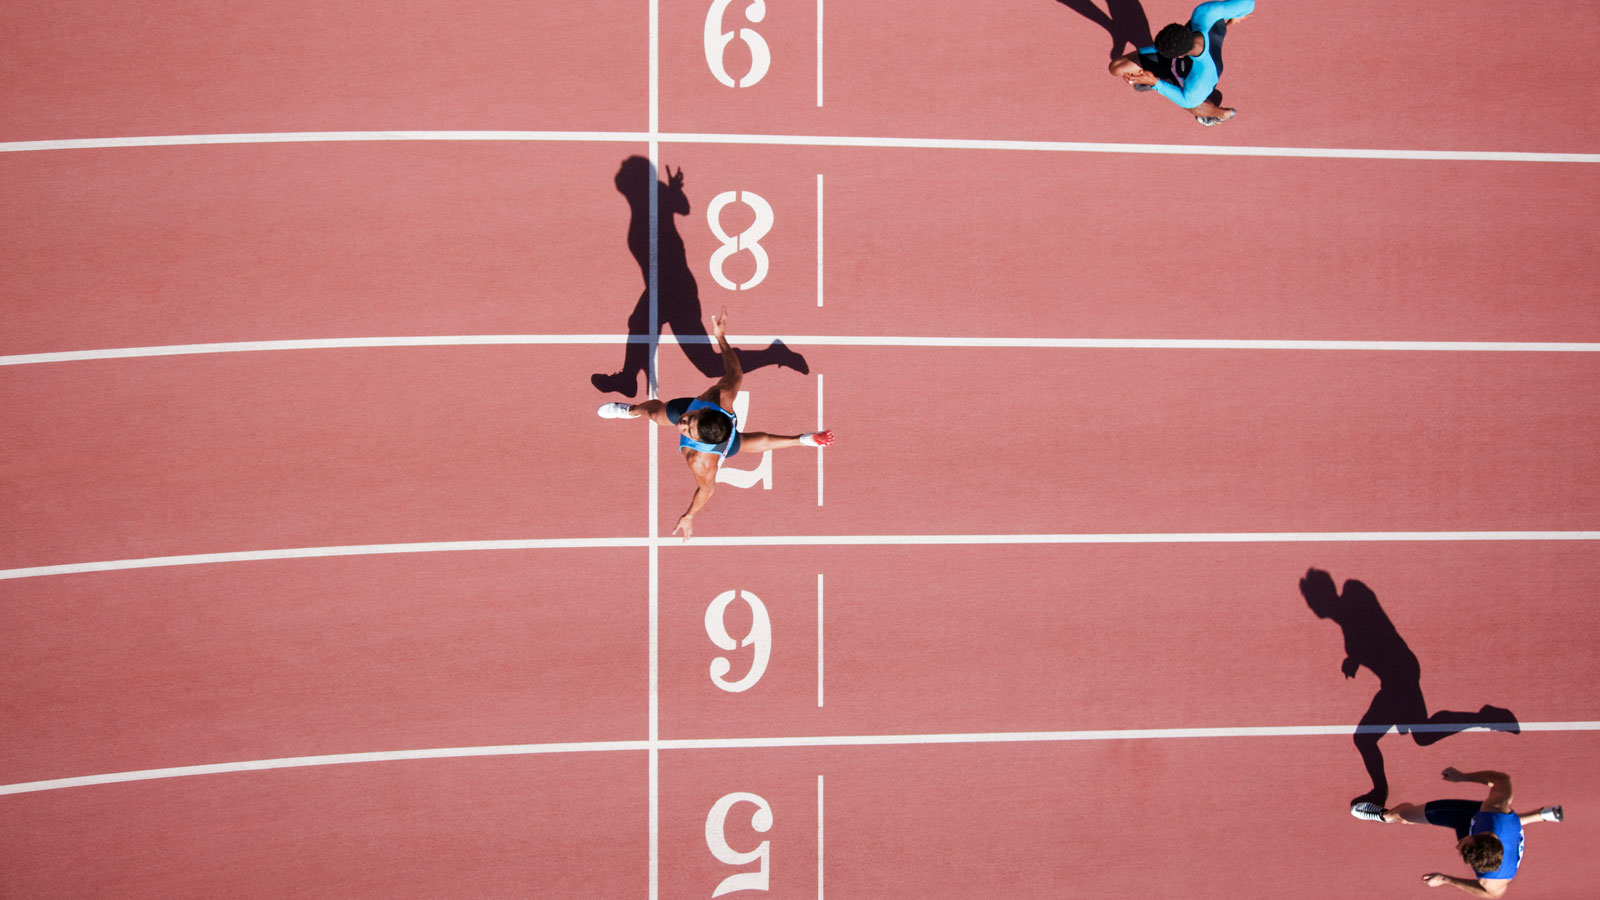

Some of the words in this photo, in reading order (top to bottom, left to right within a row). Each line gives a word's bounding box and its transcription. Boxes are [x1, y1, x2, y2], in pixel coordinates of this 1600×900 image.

[704, 0, 771, 88] 9
[707, 191, 774, 290] 8
[705, 590, 772, 692] 6
[705, 792, 774, 898] 5
